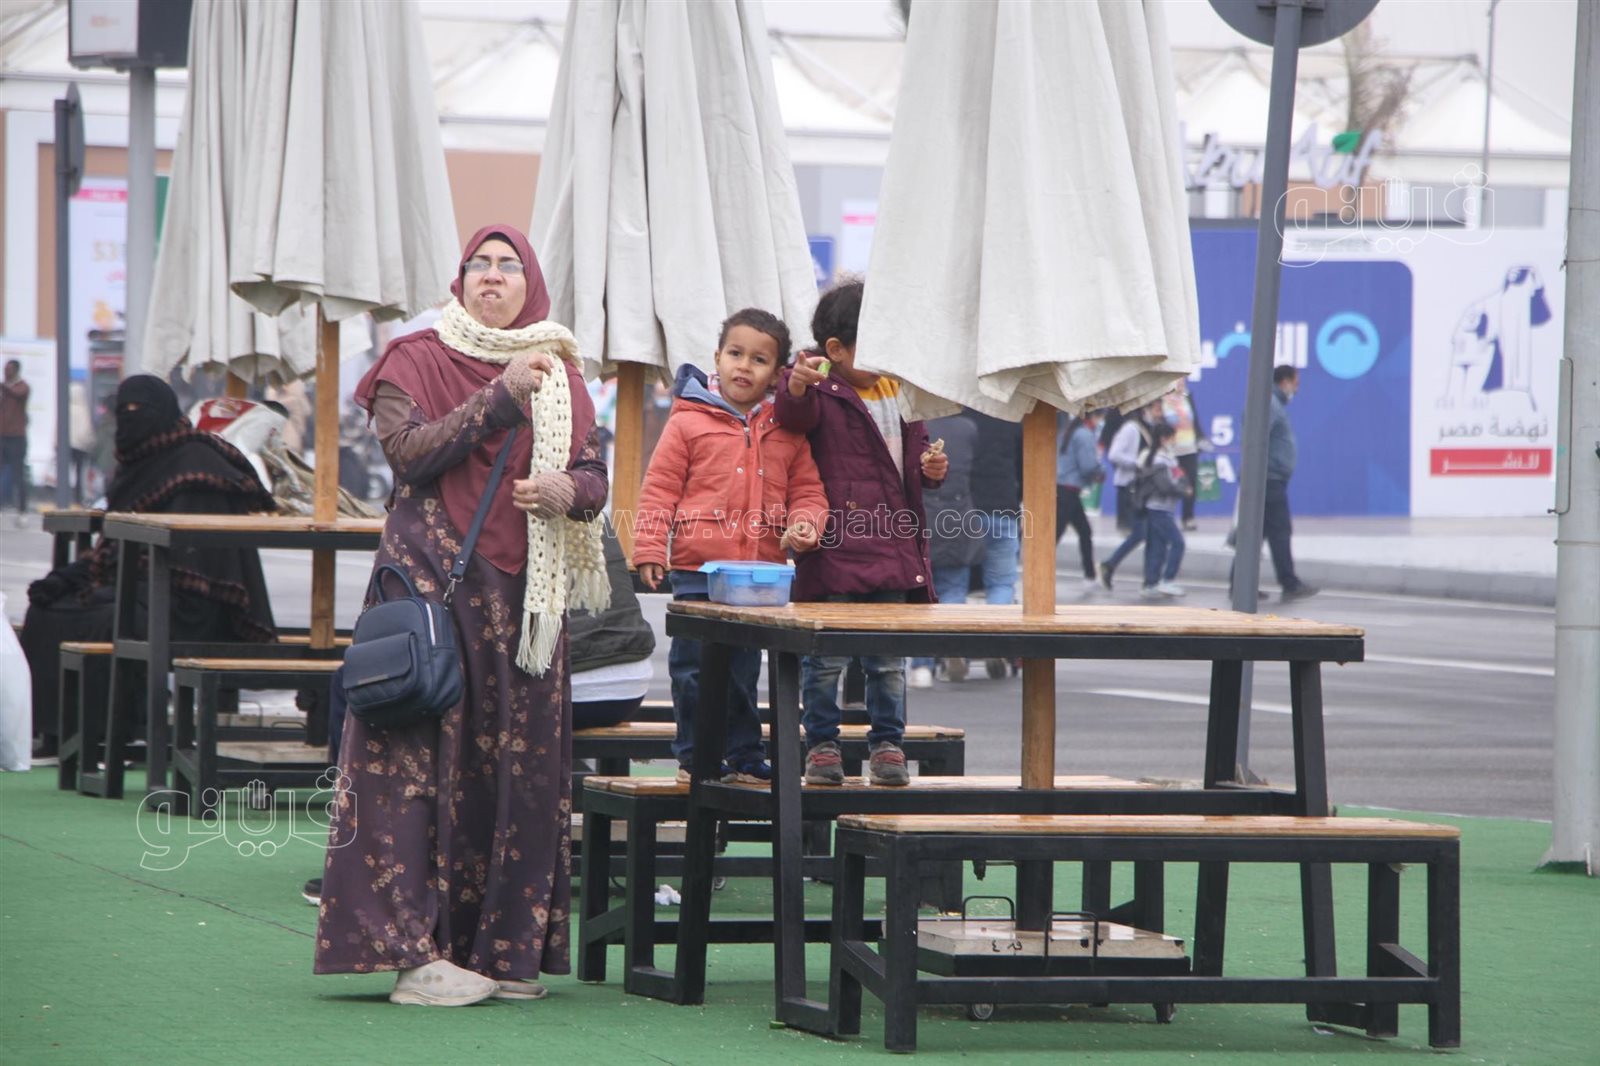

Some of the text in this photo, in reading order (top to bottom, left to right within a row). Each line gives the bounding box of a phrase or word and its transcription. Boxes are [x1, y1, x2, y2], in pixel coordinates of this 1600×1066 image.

[1211, 415, 1234, 446] 5
[1438, 416, 1548, 443] نهضة مصر
